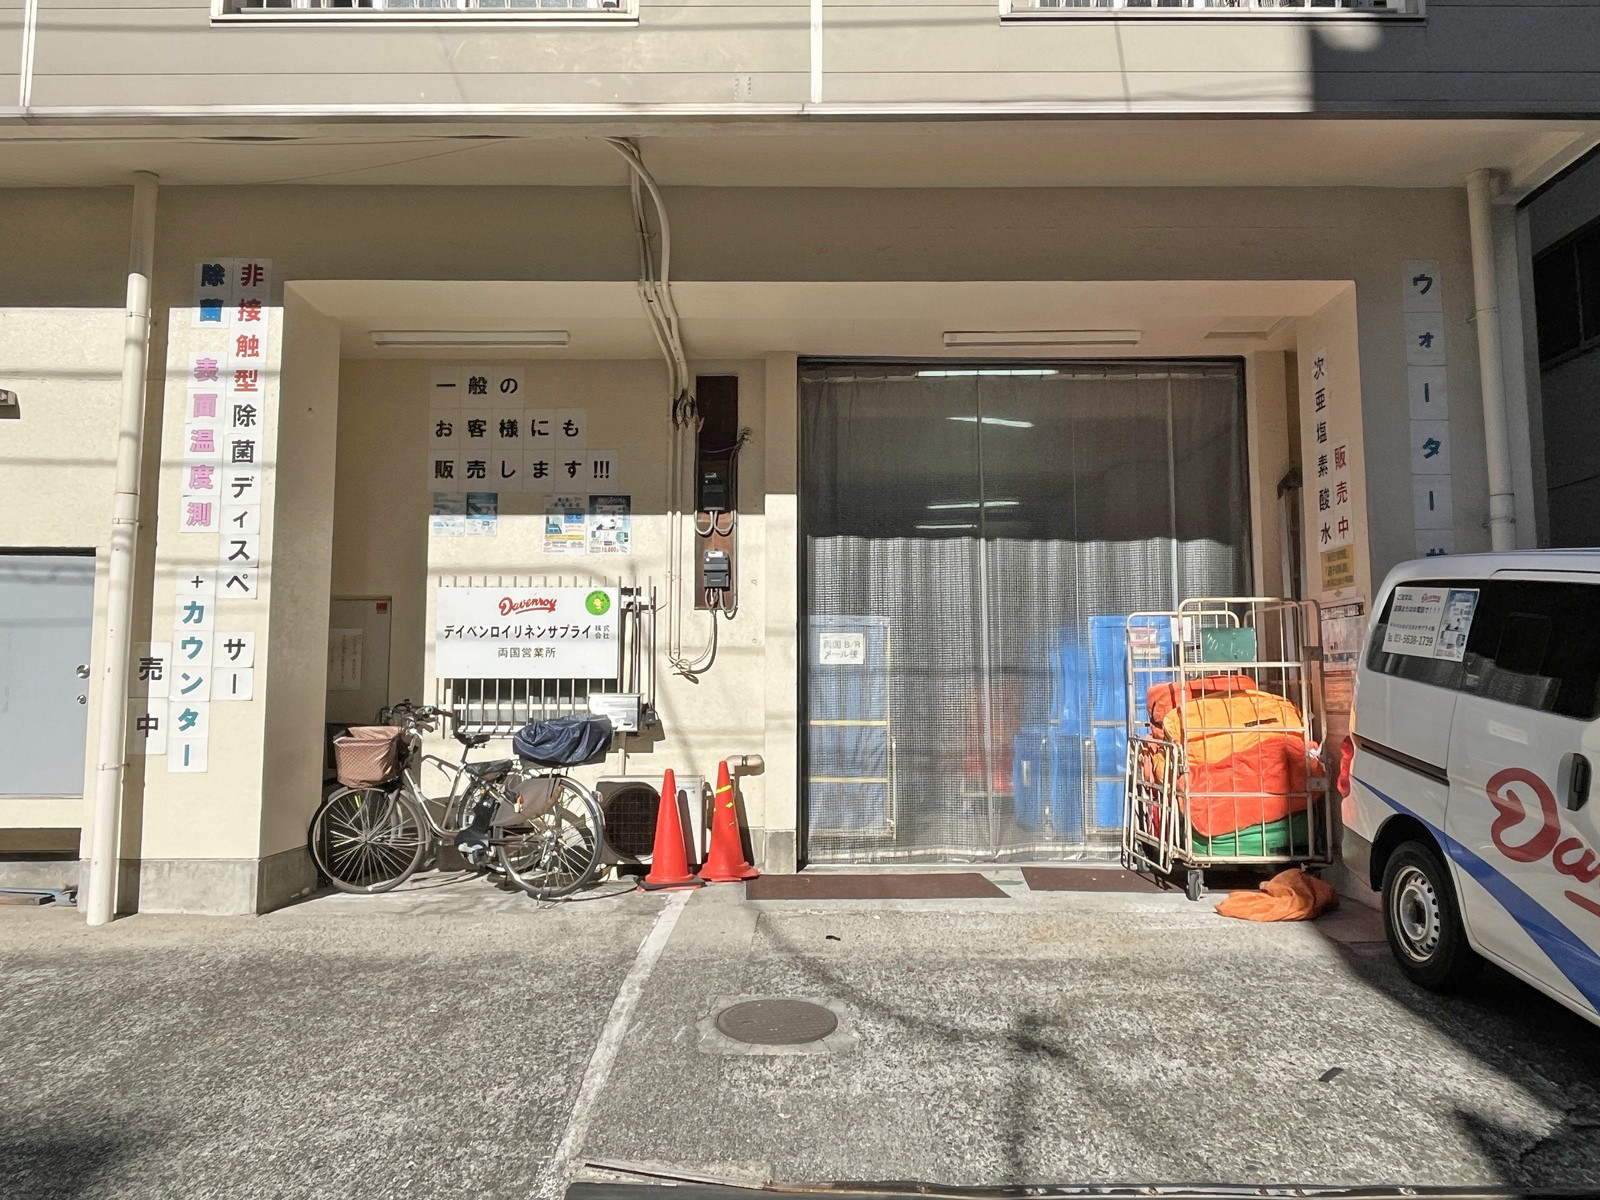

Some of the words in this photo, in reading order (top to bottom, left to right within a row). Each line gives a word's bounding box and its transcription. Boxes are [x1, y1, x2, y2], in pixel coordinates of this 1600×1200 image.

[436, 375, 519, 396] 一般の
[435, 418, 580, 439] お客様にも
[1313, 356, 1331, 545] 次亜塩素酸水
[434, 459, 611, 480] 販売します!!!
[1334, 444, 1350, 540] 販売中
[498, 596, 557, 616] Davenroy
[497, 646, 557, 659] 両国営業所
